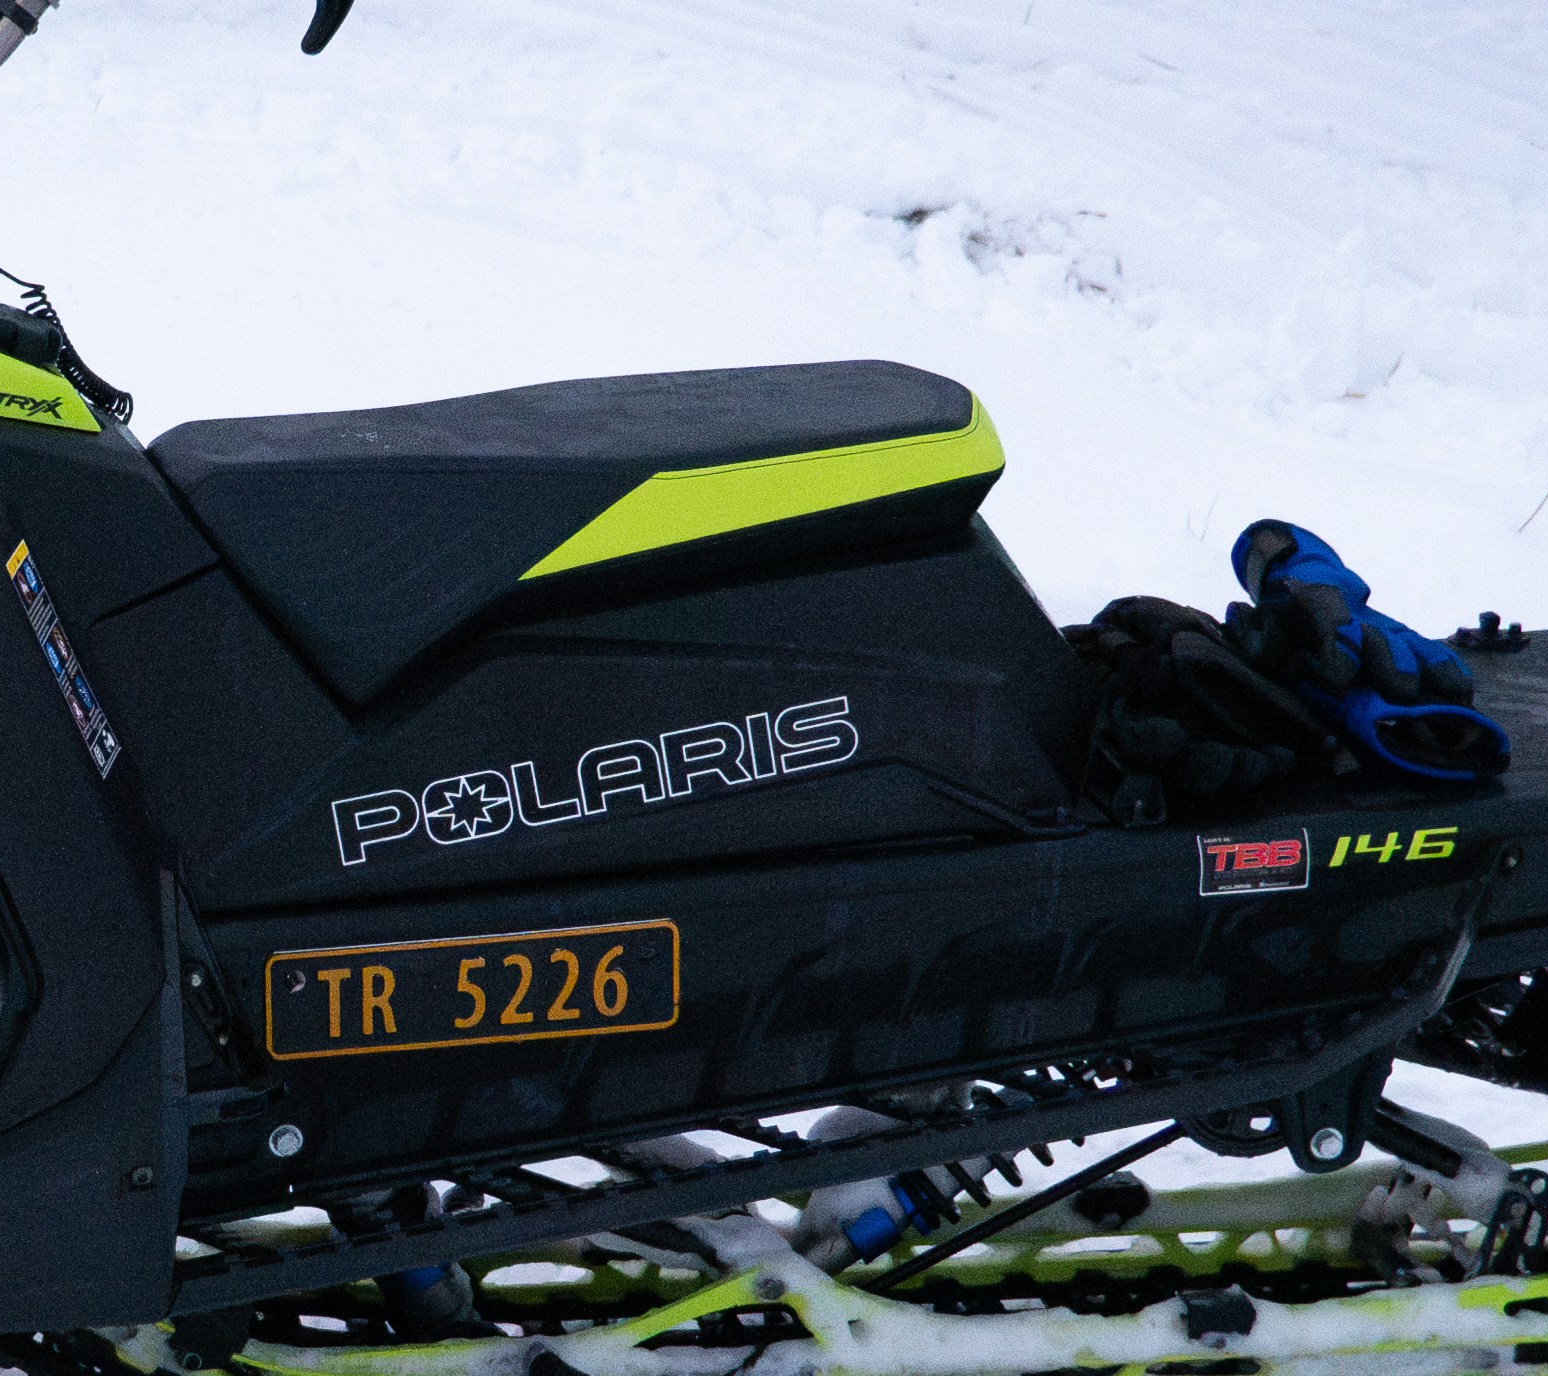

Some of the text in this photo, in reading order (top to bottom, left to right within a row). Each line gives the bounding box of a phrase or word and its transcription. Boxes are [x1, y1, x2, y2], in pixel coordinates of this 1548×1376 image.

[332, 695, 859, 867] POLARIS
[1207, 839, 1302, 872] TBB
[1328, 826, 1459, 868] 146
[316, 944, 630, 1038] TR 5226
